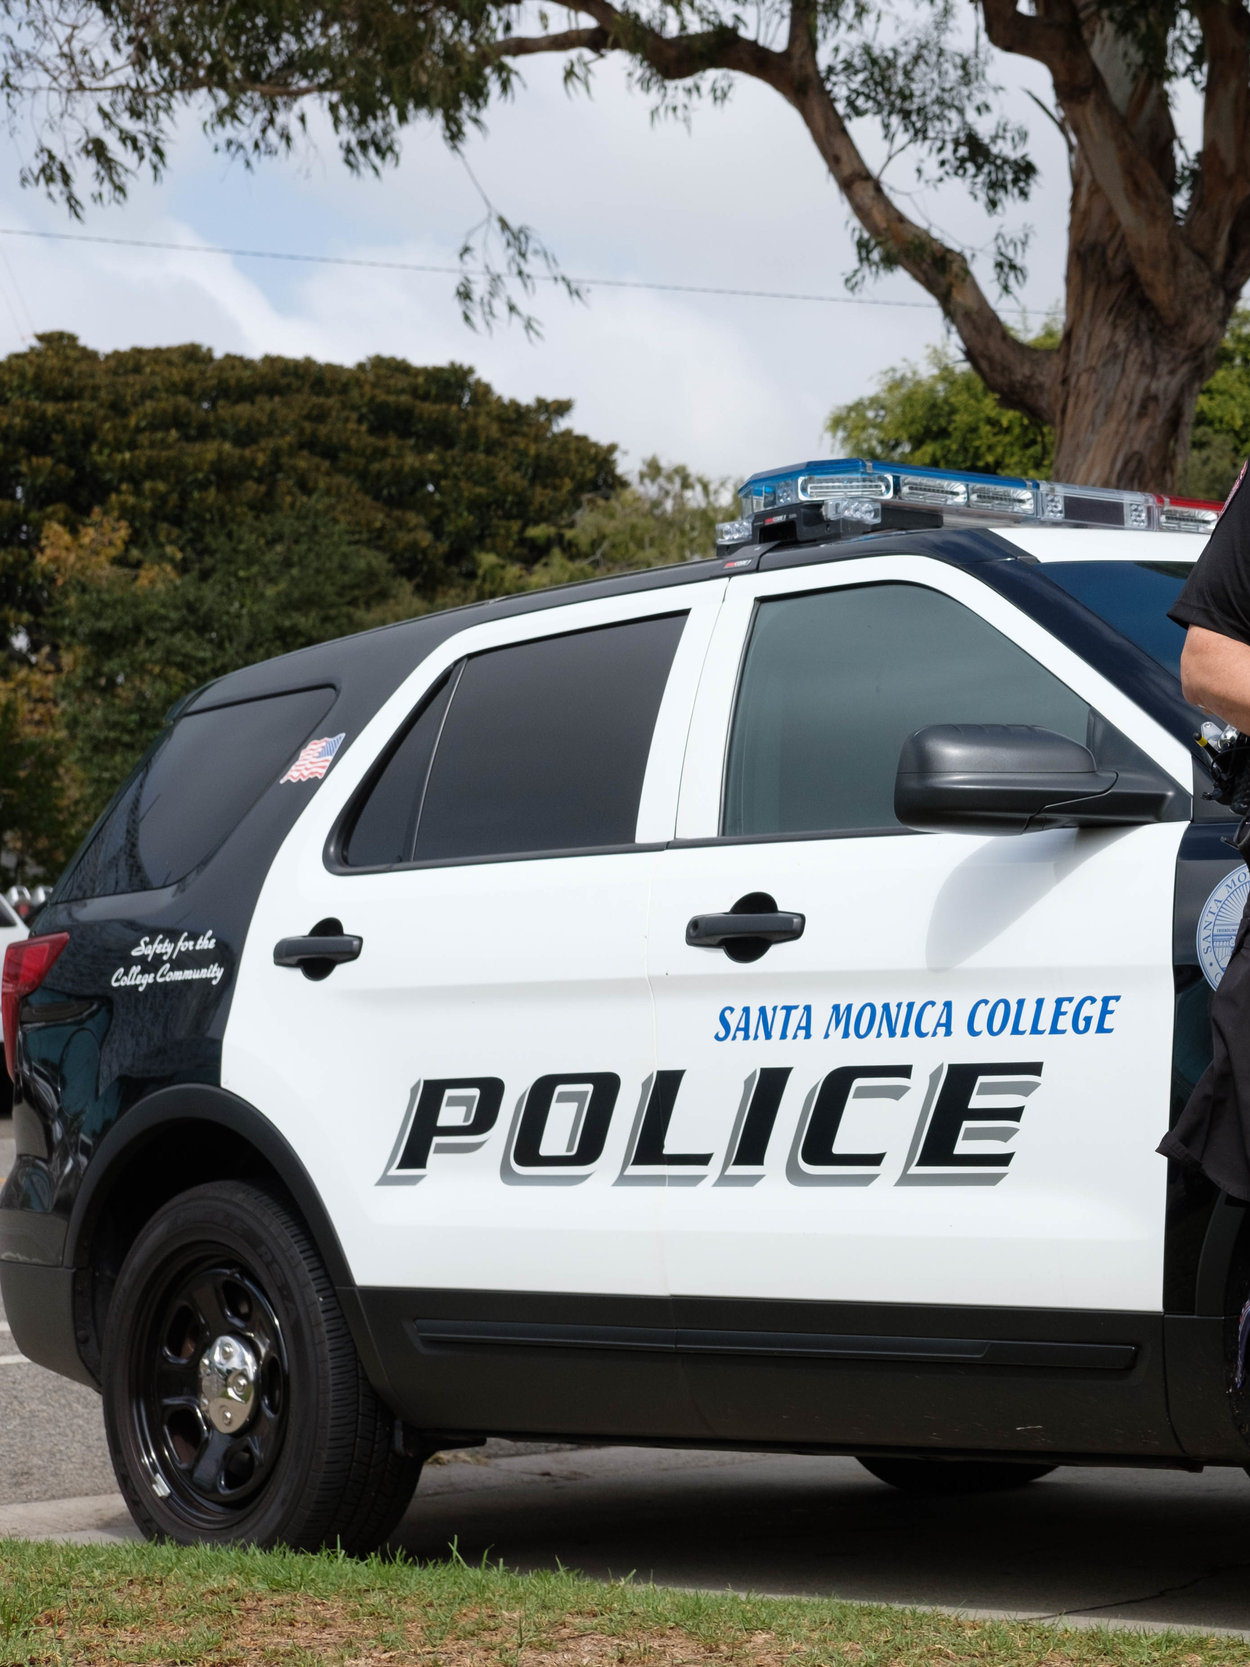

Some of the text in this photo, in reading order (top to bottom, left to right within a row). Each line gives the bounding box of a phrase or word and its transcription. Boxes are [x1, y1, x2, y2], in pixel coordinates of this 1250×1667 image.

[131, 929, 216, 962] Safety for the
[1202, 898, 1223, 955] SANTA
[111, 962, 224, 992] College Community
[714, 995, 1122, 1042] SANTA MONICA COLLEGE
[374, 1061, 1044, 1187] POLICE
